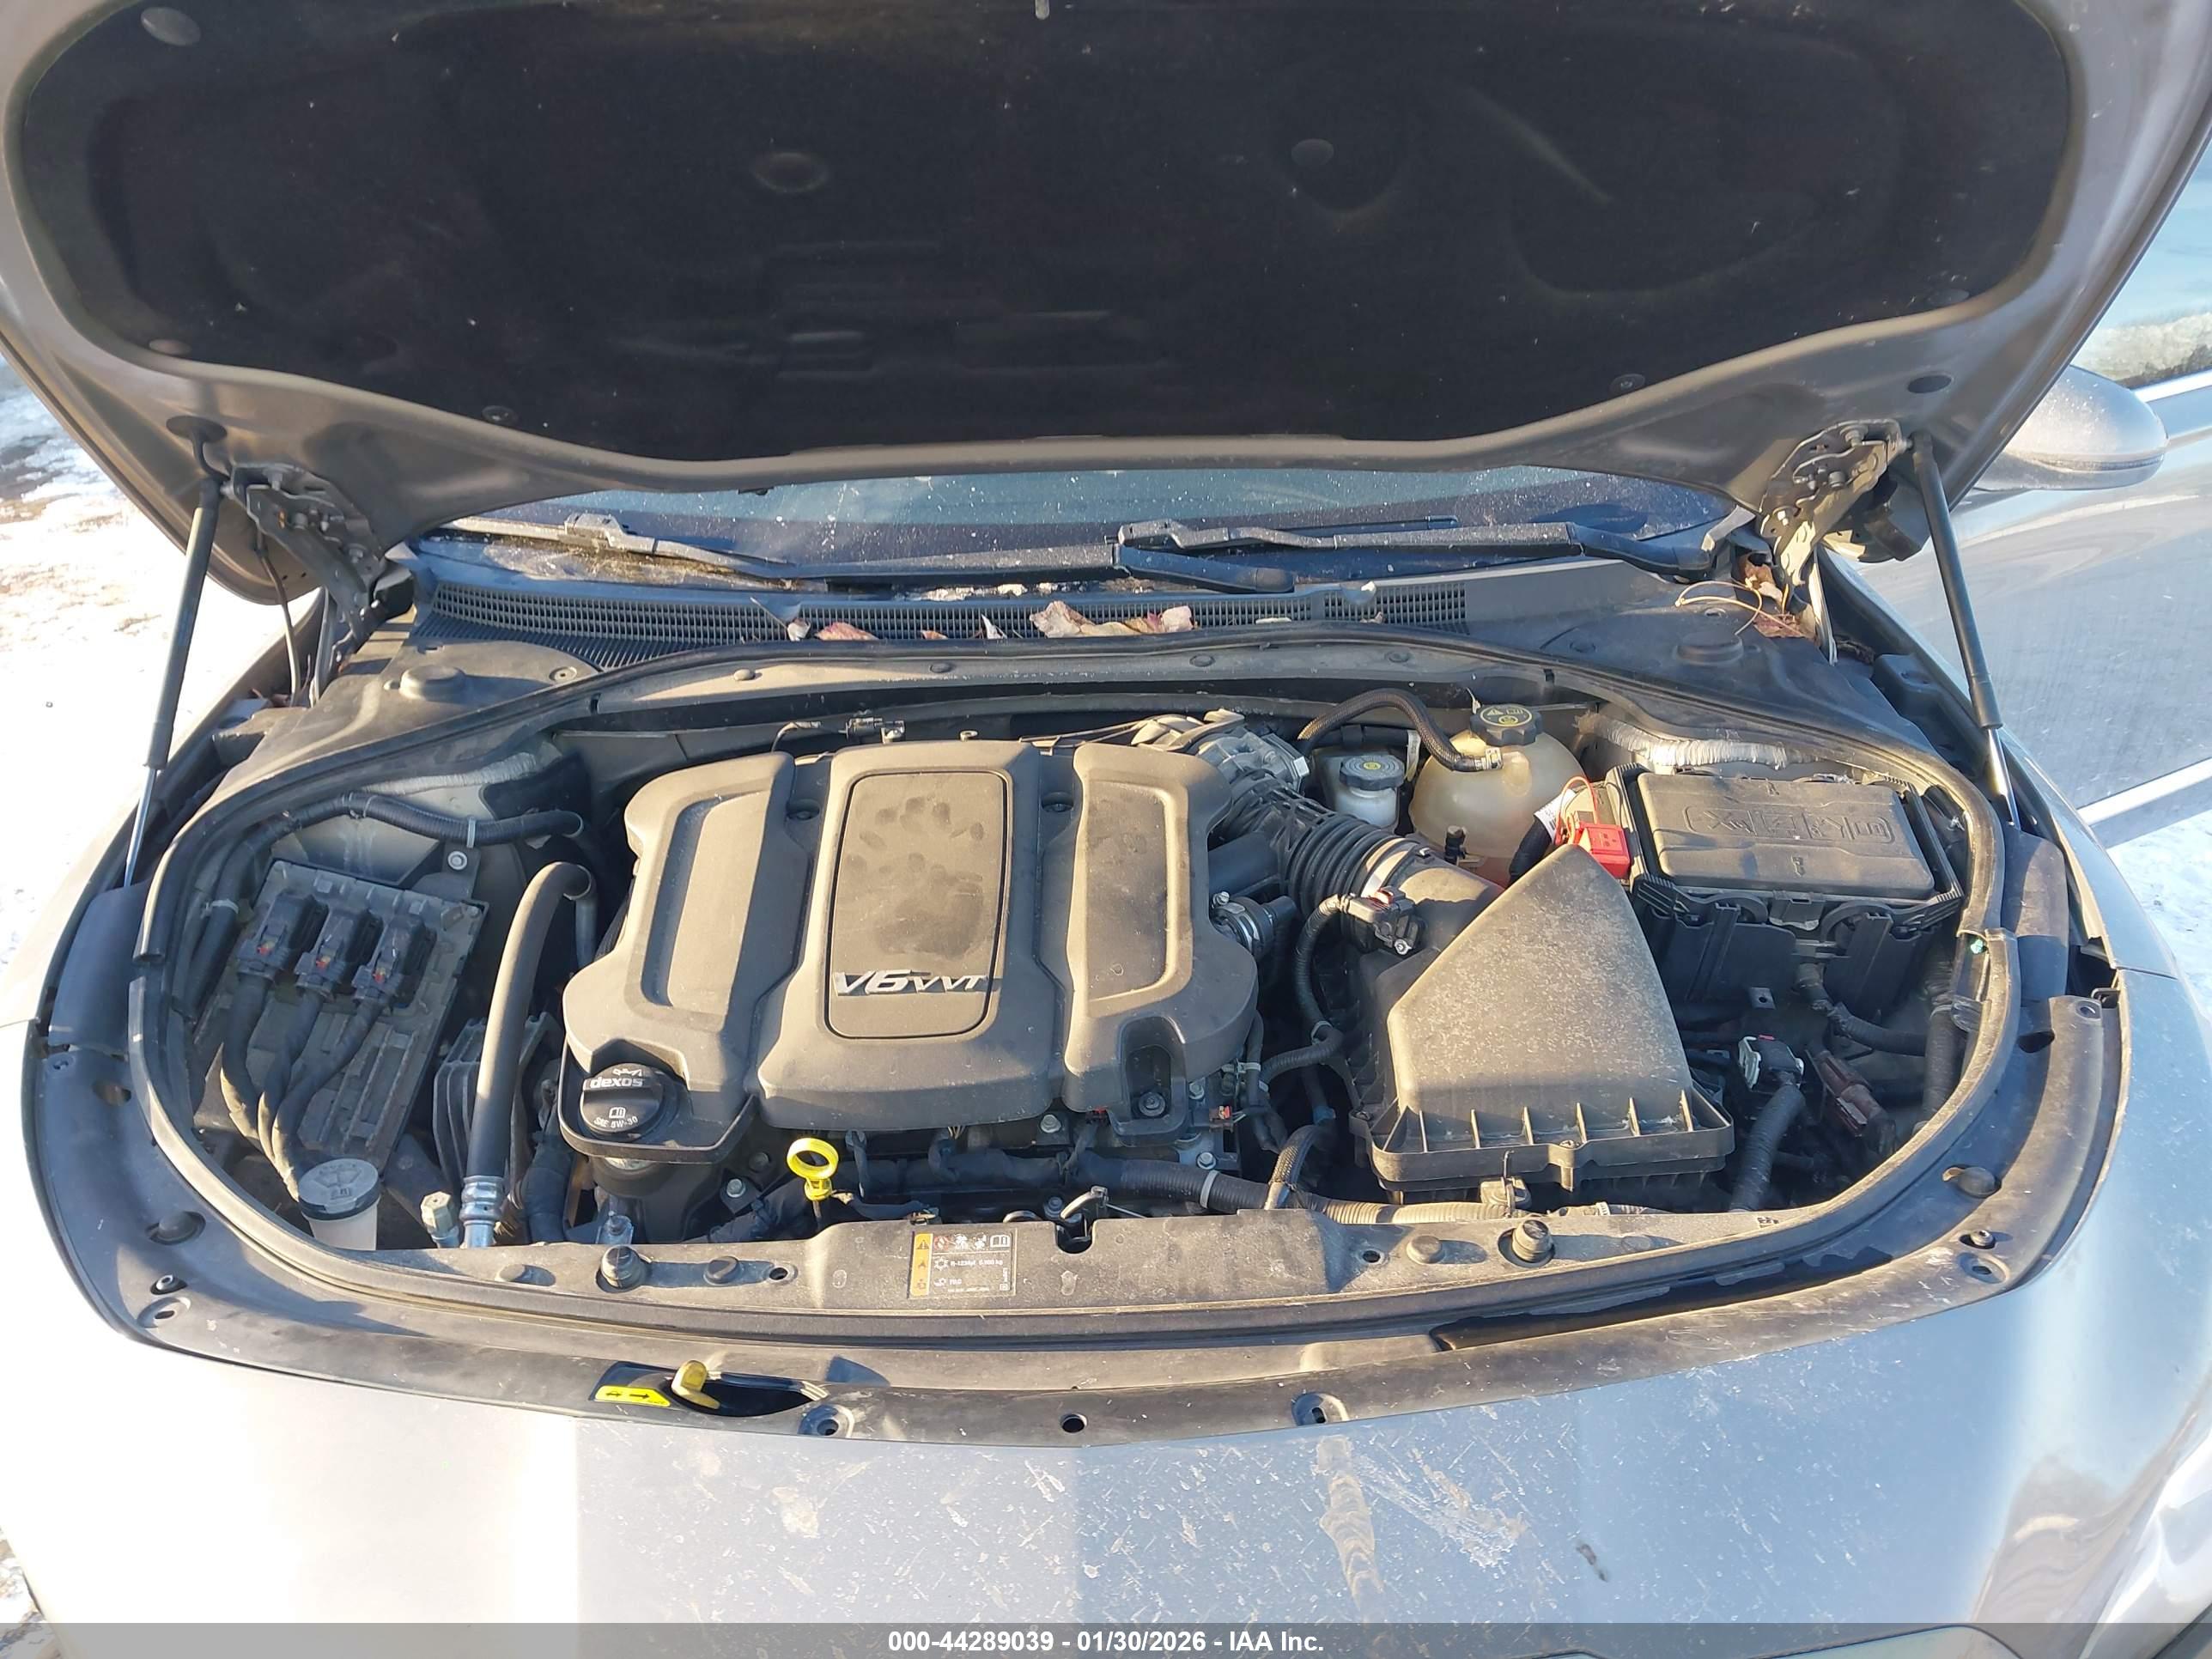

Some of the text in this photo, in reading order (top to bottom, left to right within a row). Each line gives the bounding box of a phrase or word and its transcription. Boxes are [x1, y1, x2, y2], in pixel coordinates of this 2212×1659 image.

[833, 969, 988, 996] V6 VVT
[589, 1076, 643, 1089] dexos
[593, 1115, 638, 1128] SAE 5W-30
